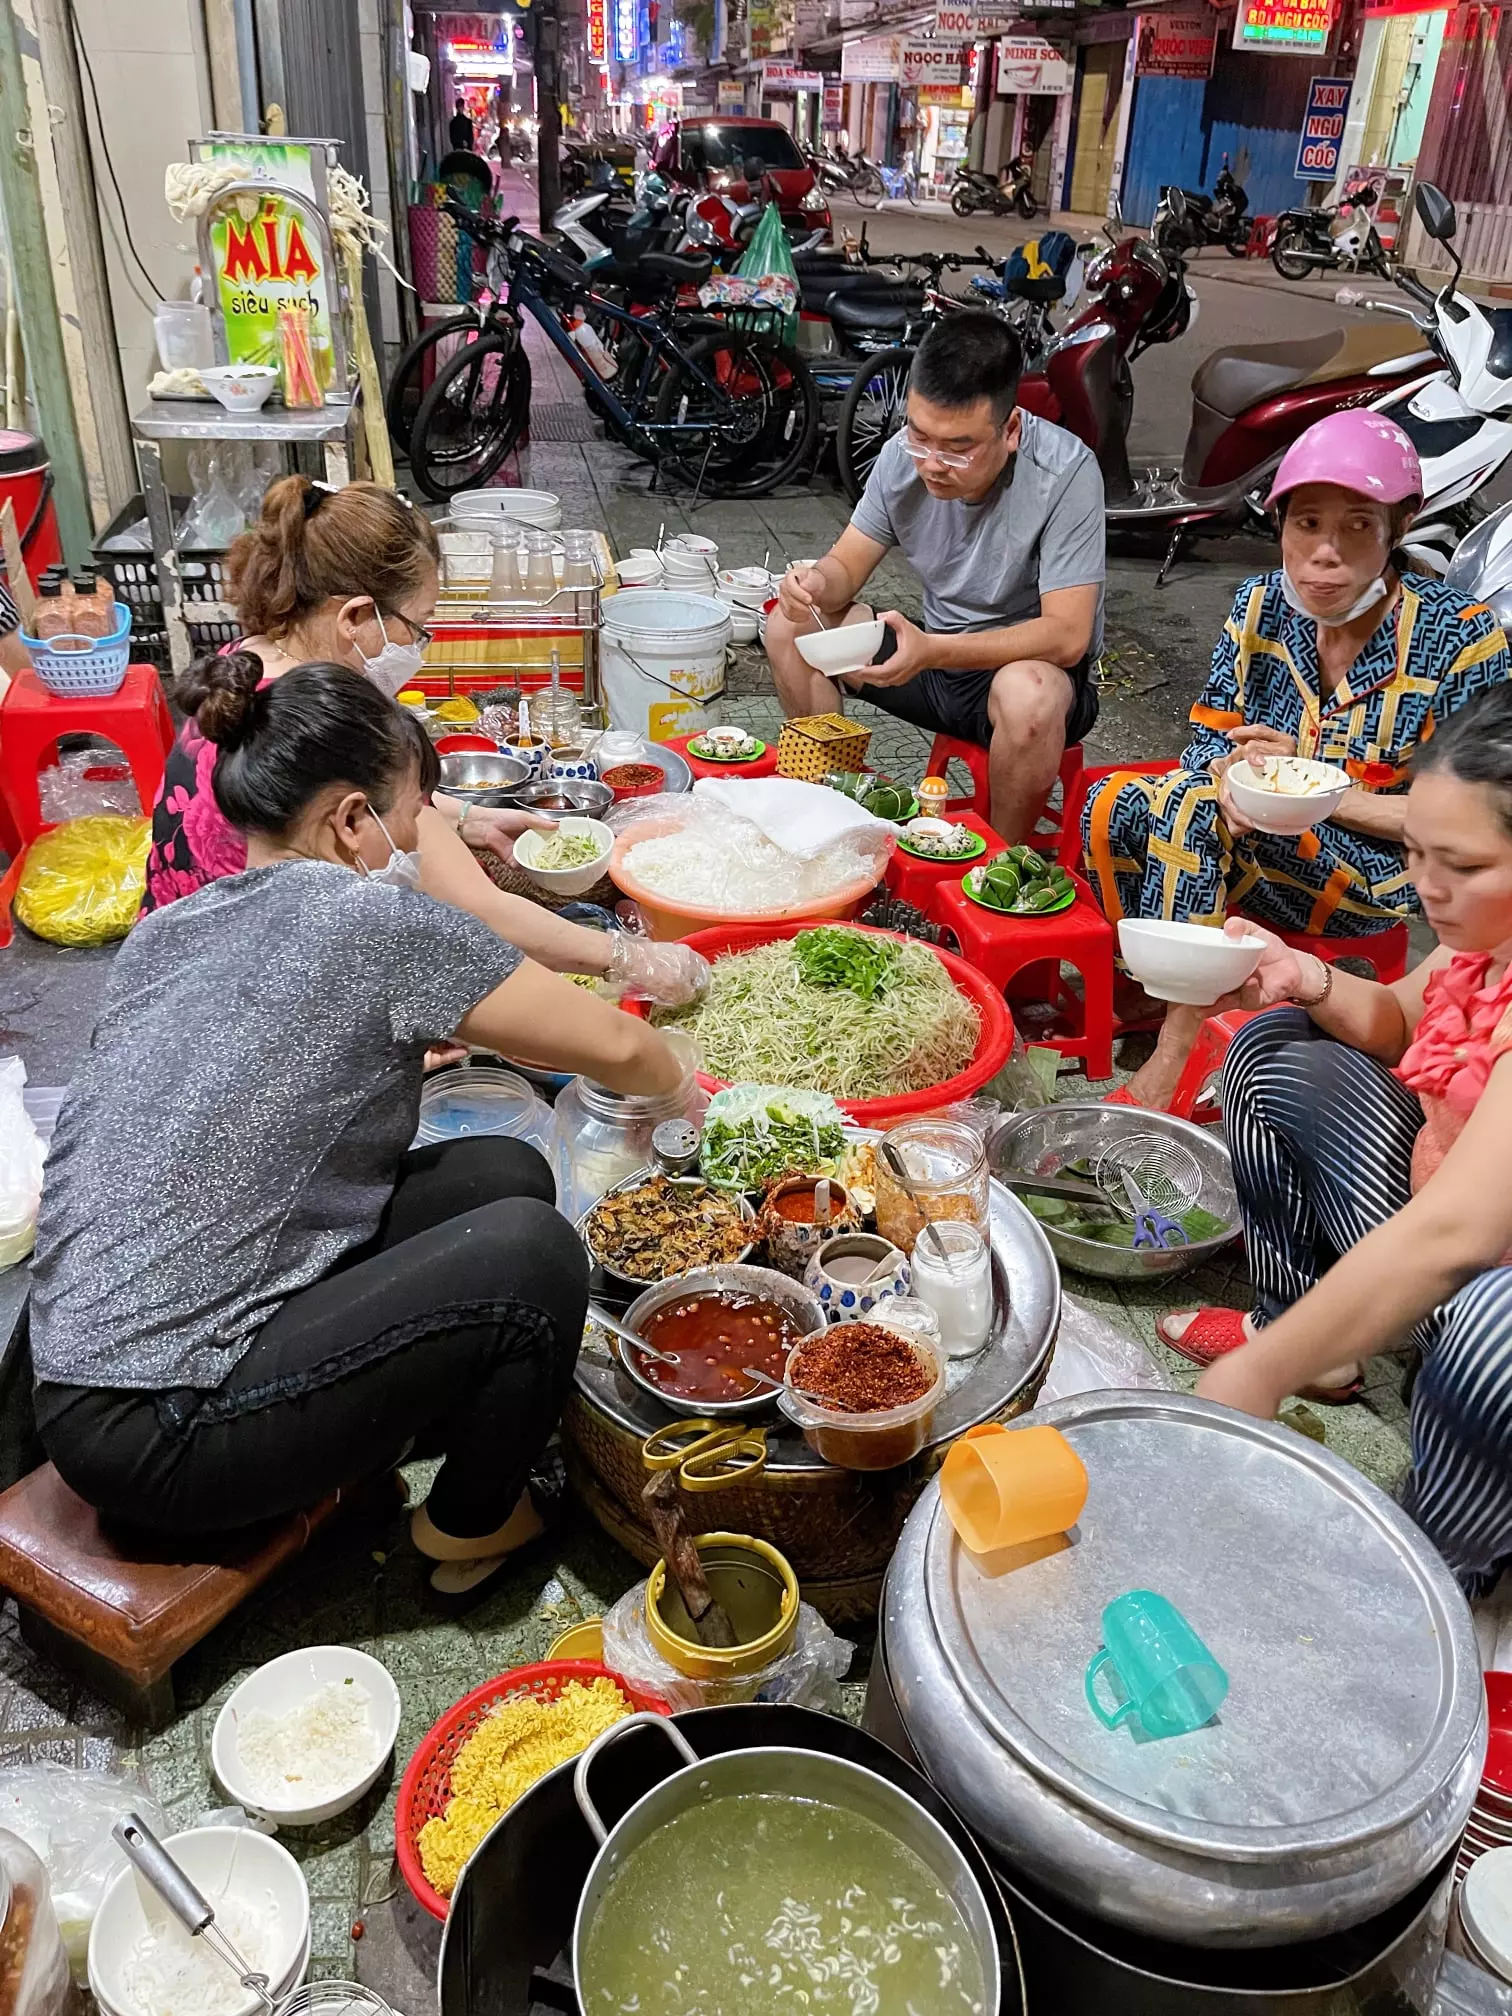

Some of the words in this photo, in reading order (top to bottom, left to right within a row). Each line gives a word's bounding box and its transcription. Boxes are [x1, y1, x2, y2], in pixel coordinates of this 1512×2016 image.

[1005, 47, 1037, 60] MINH
[1312, 85, 1348, 108] XAY
[1307, 114, 1343, 138] NGŨ
[1302, 140, 1337, 169] CỐC
[222, 202, 319, 285] MÍA
[232, 290, 268, 313] siêu
